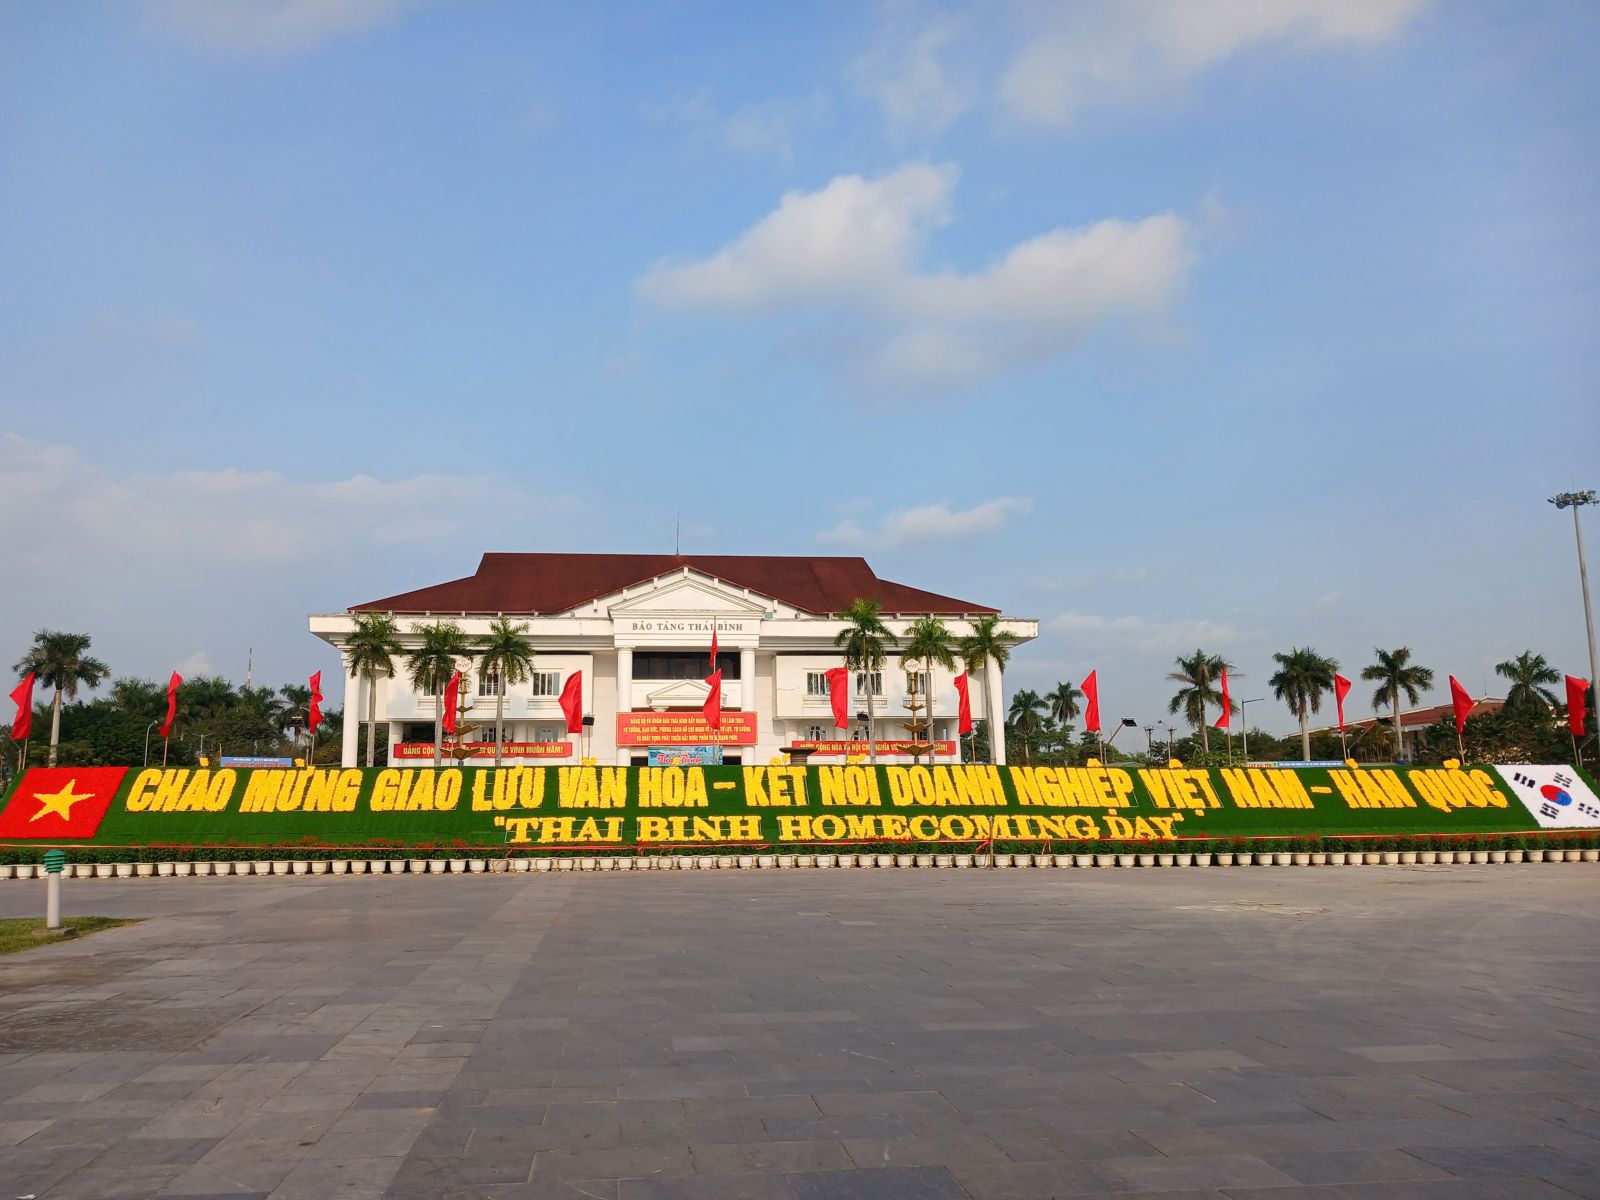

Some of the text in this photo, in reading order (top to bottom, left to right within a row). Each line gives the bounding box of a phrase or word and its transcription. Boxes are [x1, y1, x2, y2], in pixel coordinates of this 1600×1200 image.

[632, 620, 743, 631] BẢO TÀNG THÁI BÌNH
[239, 758, 362, 813] MỪNG
[369, 768, 463, 812] GIAO
[472, 764, 545, 812] LƯU
[559, 757, 626, 809] VĂN
[742, 752, 806, 807] KẾT
[819, 752, 882, 806] NỐI
[885, 765, 1008, 807] DOANH
[1009, 758, 1134, 816] NGHIỆP
[1138, 759, 1220, 818] VIỆT
[1220, 768, 1315, 809] NAM
[1327, 758, 1418, 809] HÀN
[1408, 758, 1512, 813] QUỐC
[636, 816, 764, 842] BINH
[777, 815, 1101, 842] HOMECOMING
